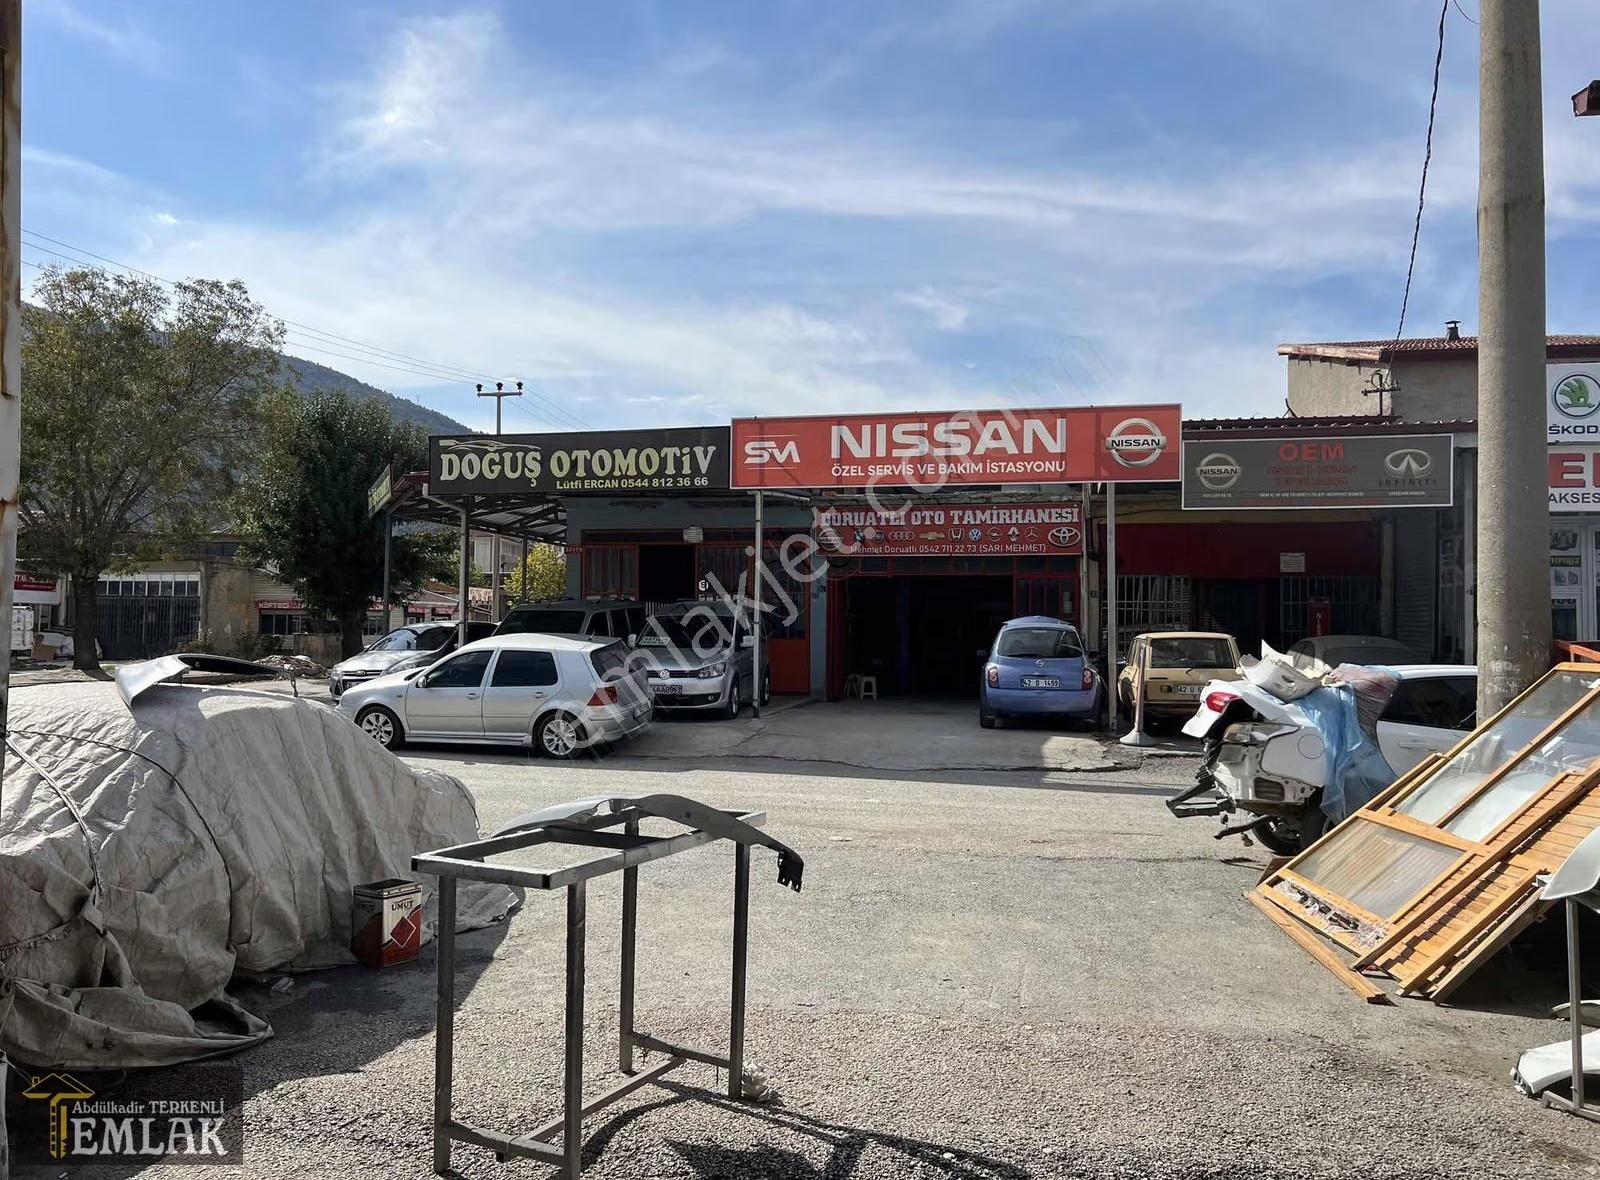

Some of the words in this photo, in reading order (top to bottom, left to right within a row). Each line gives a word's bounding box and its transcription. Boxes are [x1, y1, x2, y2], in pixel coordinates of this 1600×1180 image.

[1548, 424, 1600, 435] ŠKOD
[831, 418, 1067, 459] NISSAN
[1111, 438, 1160, 447] NISSAN
[1279, 443, 1345, 460] OEM
[831, 464, 865, 477] ÖZEL
[867, 461, 914, 476] SERVİS
[917, 463, 936, 475] VE
[938, 463, 983, 475] BAKIM
[986, 459, 1066, 474] İSTASYONU
[1200, 467, 1238, 475] NISSAN
[556, 480, 582, 490] Lütfi
[584, 479, 619, 489] ERCAN
[621, 478, 650, 488] 0544
[652, 477, 674, 487] 812
[677, 477, 691, 487] 36
[694, 476, 710, 486] 66
[911, 510, 945, 526] OTO
[950, 504, 1080, 525] TAMİRHANESİ
[919, 544, 940, 553] 0542
[942, 544, 953, 552] 711
[955, 544, 966, 552] 22
[967, 543, 977, 552] 73
[1005, 543, 1047, 552] MEHMET)
[391, 900, 414, 911] UMUT
